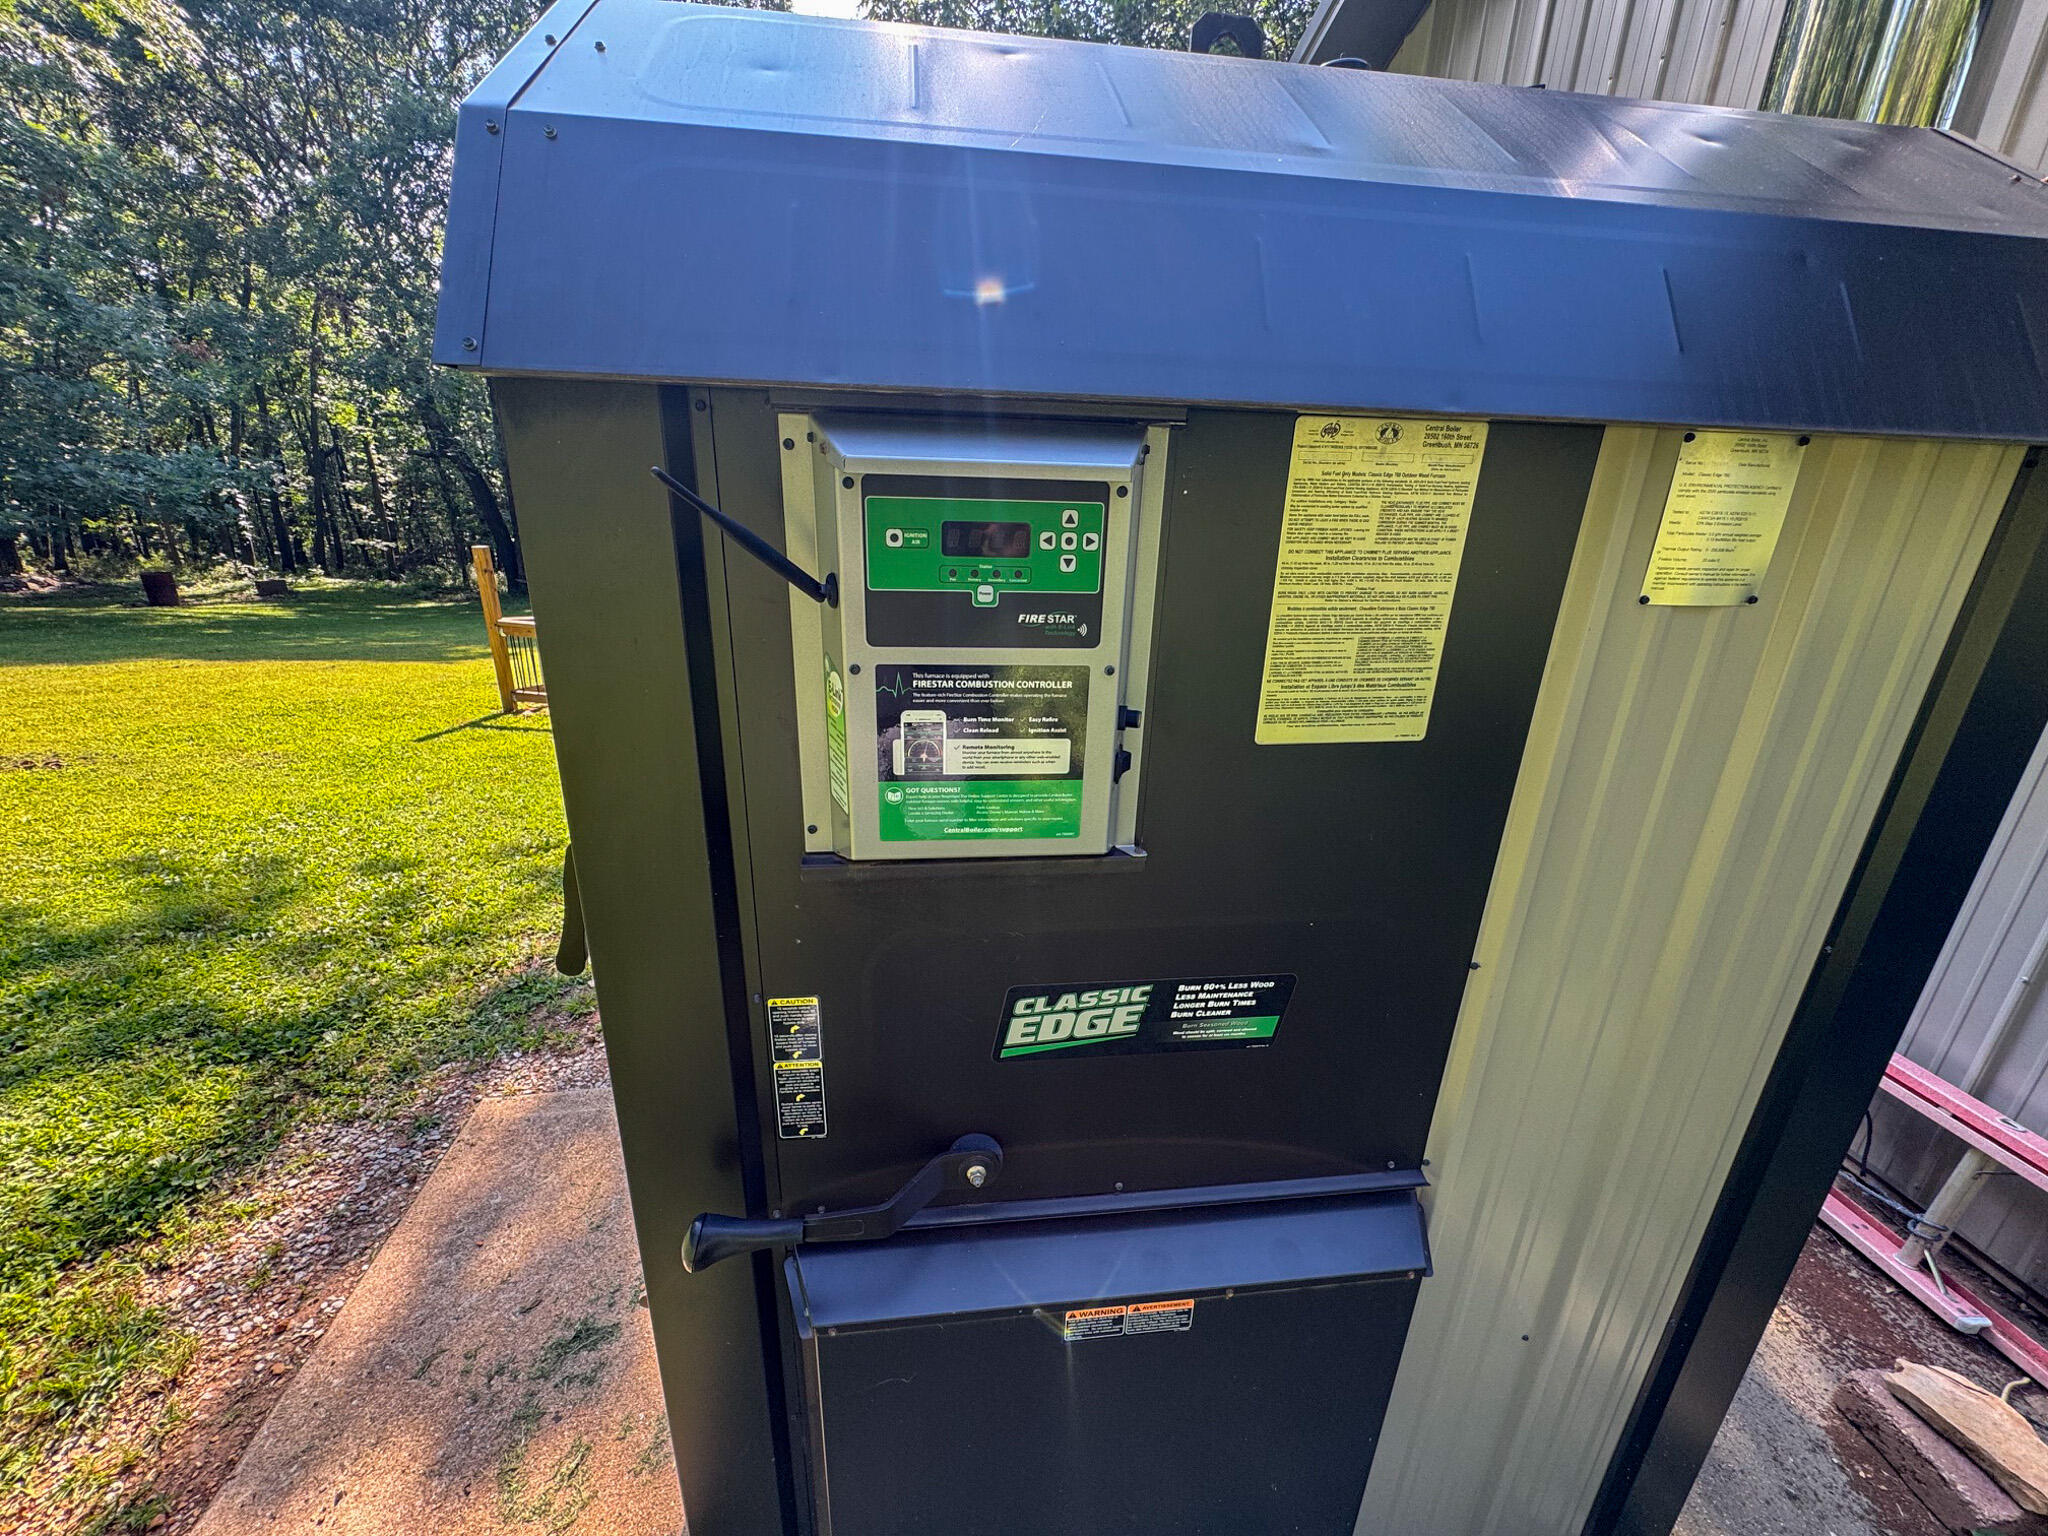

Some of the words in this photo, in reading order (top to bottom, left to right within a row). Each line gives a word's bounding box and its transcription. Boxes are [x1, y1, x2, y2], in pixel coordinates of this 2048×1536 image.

[913, 680, 954, 688] FIRESTAR
[955, 680, 1015, 689] COMBUSTION
[1016, 681, 1072, 689] CONTROLLER
[1013, 984, 1153, 1016] CLASSIC
[1004, 1003, 1148, 1047] EDGE
[1142, 1302, 1190, 1311] AVERTISSEMENT
[1079, 1308, 1124, 1317] WARNING
